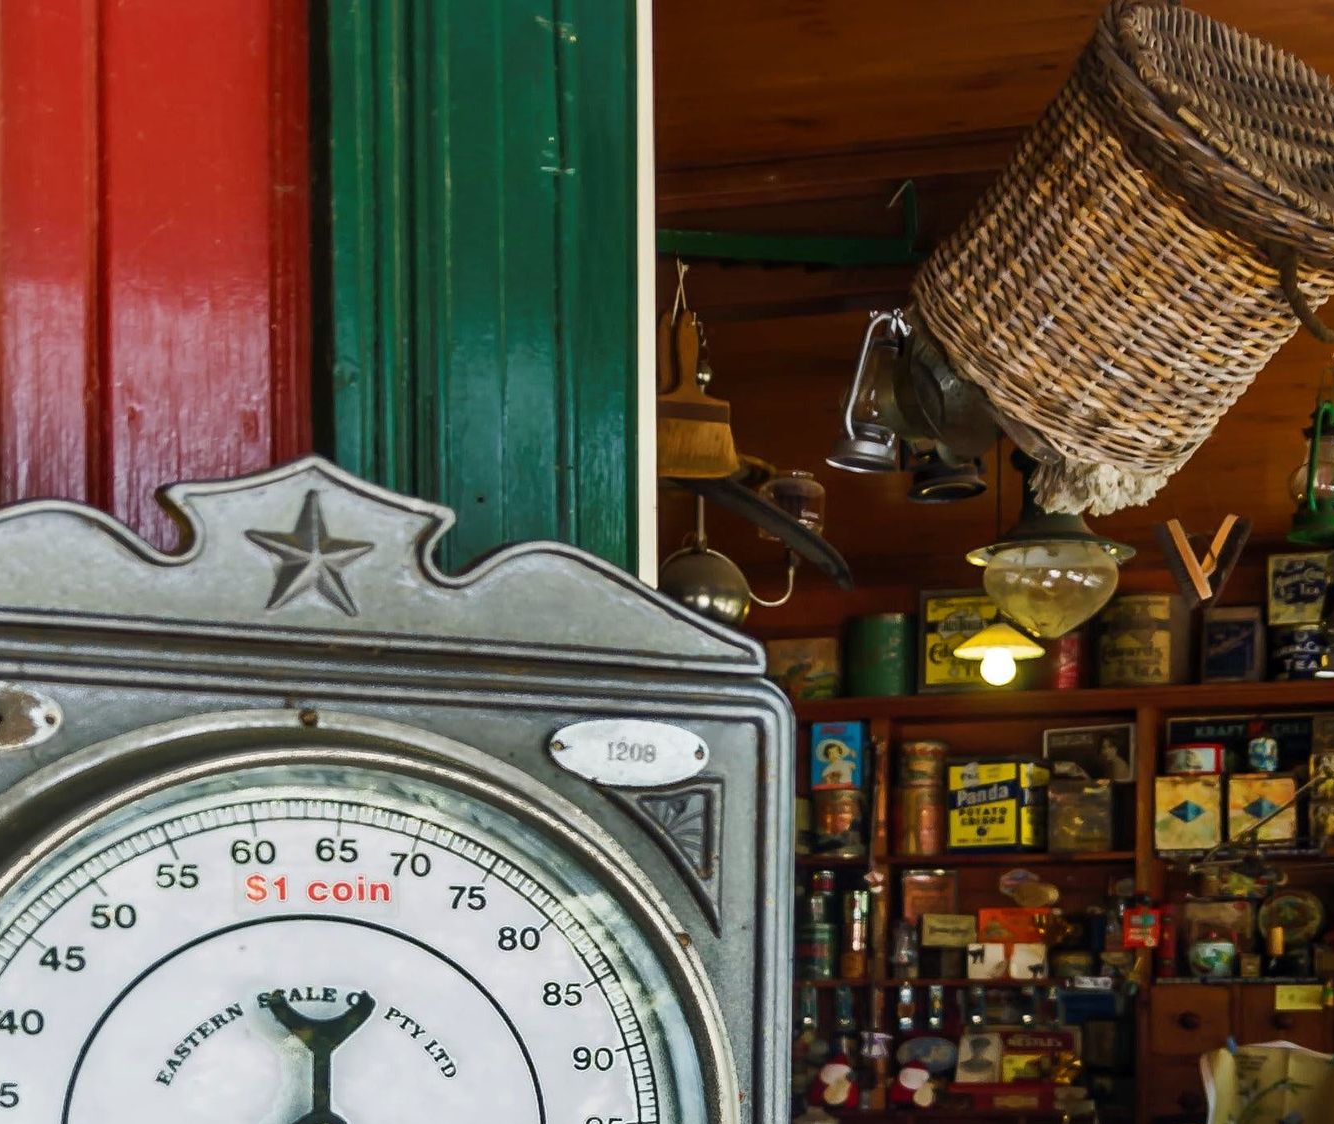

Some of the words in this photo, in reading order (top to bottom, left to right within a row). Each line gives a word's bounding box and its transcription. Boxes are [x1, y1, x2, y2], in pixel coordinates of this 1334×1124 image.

[606, 741, 657, 765] 1208
[957, 784, 1009, 806] Panda
[231, 839, 277, 866] 60
[315, 837, 359, 864] 65
[389, 849, 433, 878] 70
[154, 862, 200, 891] 55
[246, 874, 289, 907] $1
[308, 876, 392, 905] coin
[448, 884, 489, 912] 75
[89, 903, 139, 931] 50
[496, 926, 542, 952] 80
[39, 945, 87, 974] 45
[542, 981, 584, 1008] 85
[155, 1002, 245, 1086] EASTERN
[383, 1006, 426, 1041] PTY
[424, 1038, 458, 1081] LTD
[571, 1047, 615, 1072] 90
